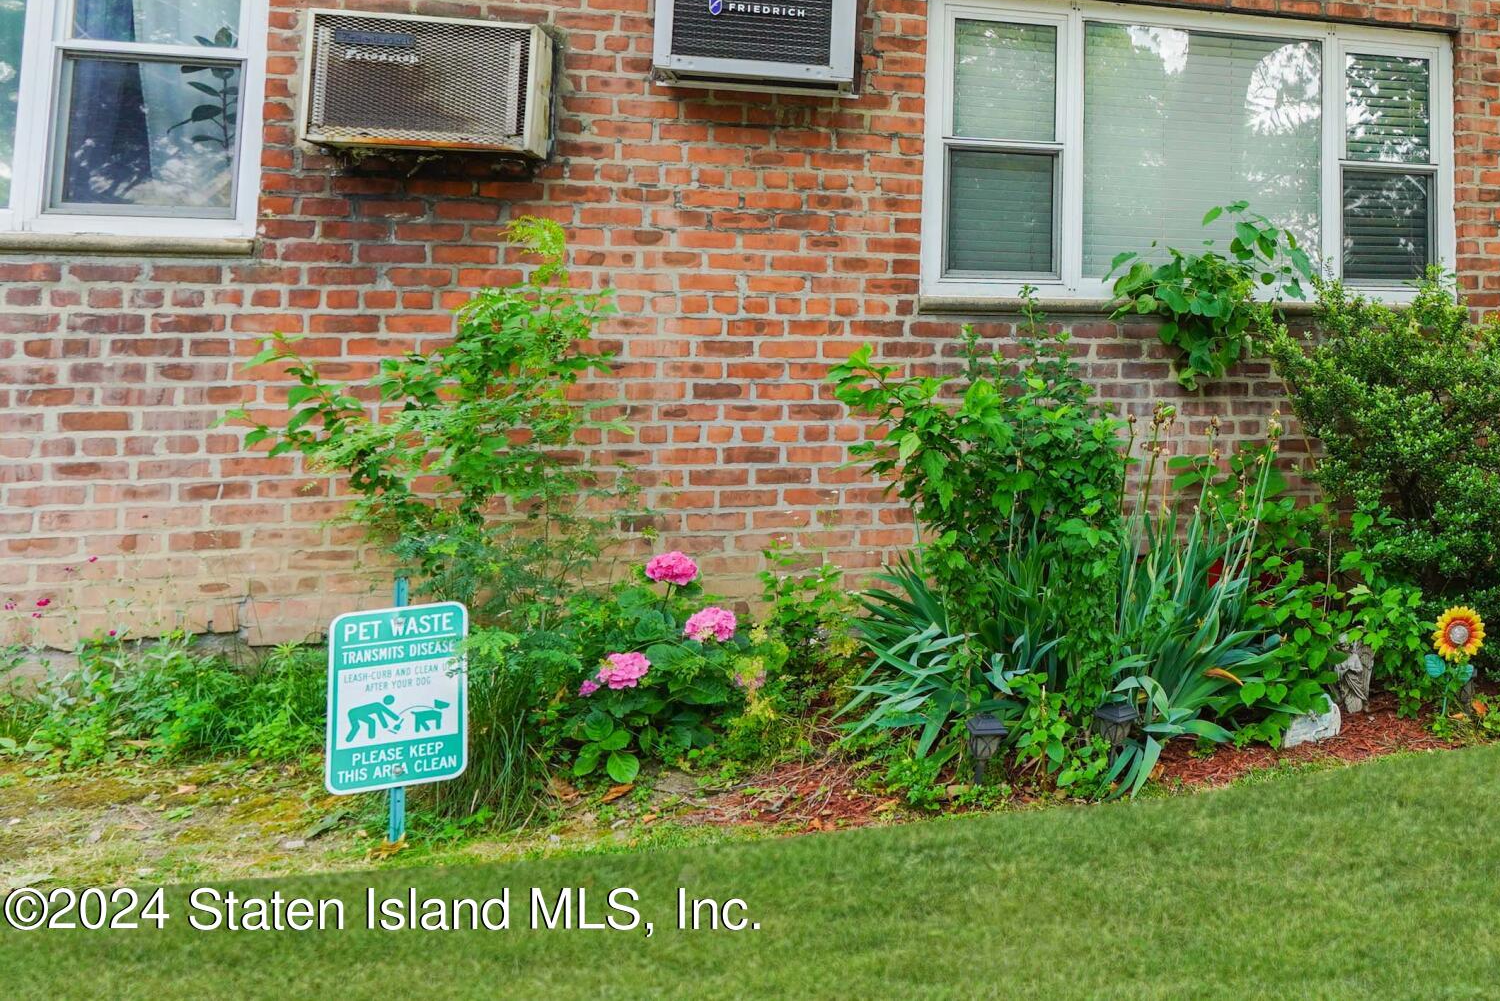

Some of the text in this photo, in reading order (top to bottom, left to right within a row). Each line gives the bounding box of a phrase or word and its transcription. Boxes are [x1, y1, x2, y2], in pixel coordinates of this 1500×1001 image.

[729, 3, 805, 17] FRIEDRICH
[343, 612, 454, 643] PET WASTE
[342, 645, 405, 666] TRANSMITS
[343, 669, 392, 684] LEASH-CURB
[395, 666, 411, 677] AND
[414, 664, 438, 674] CLEAN
[364, 676, 431, 693] AFTER YOUR DOG
[352, 741, 444, 767] PLEASE KEEP
[337, 768, 368, 784] THIS
[414, 755, 457, 773] CLEAN
